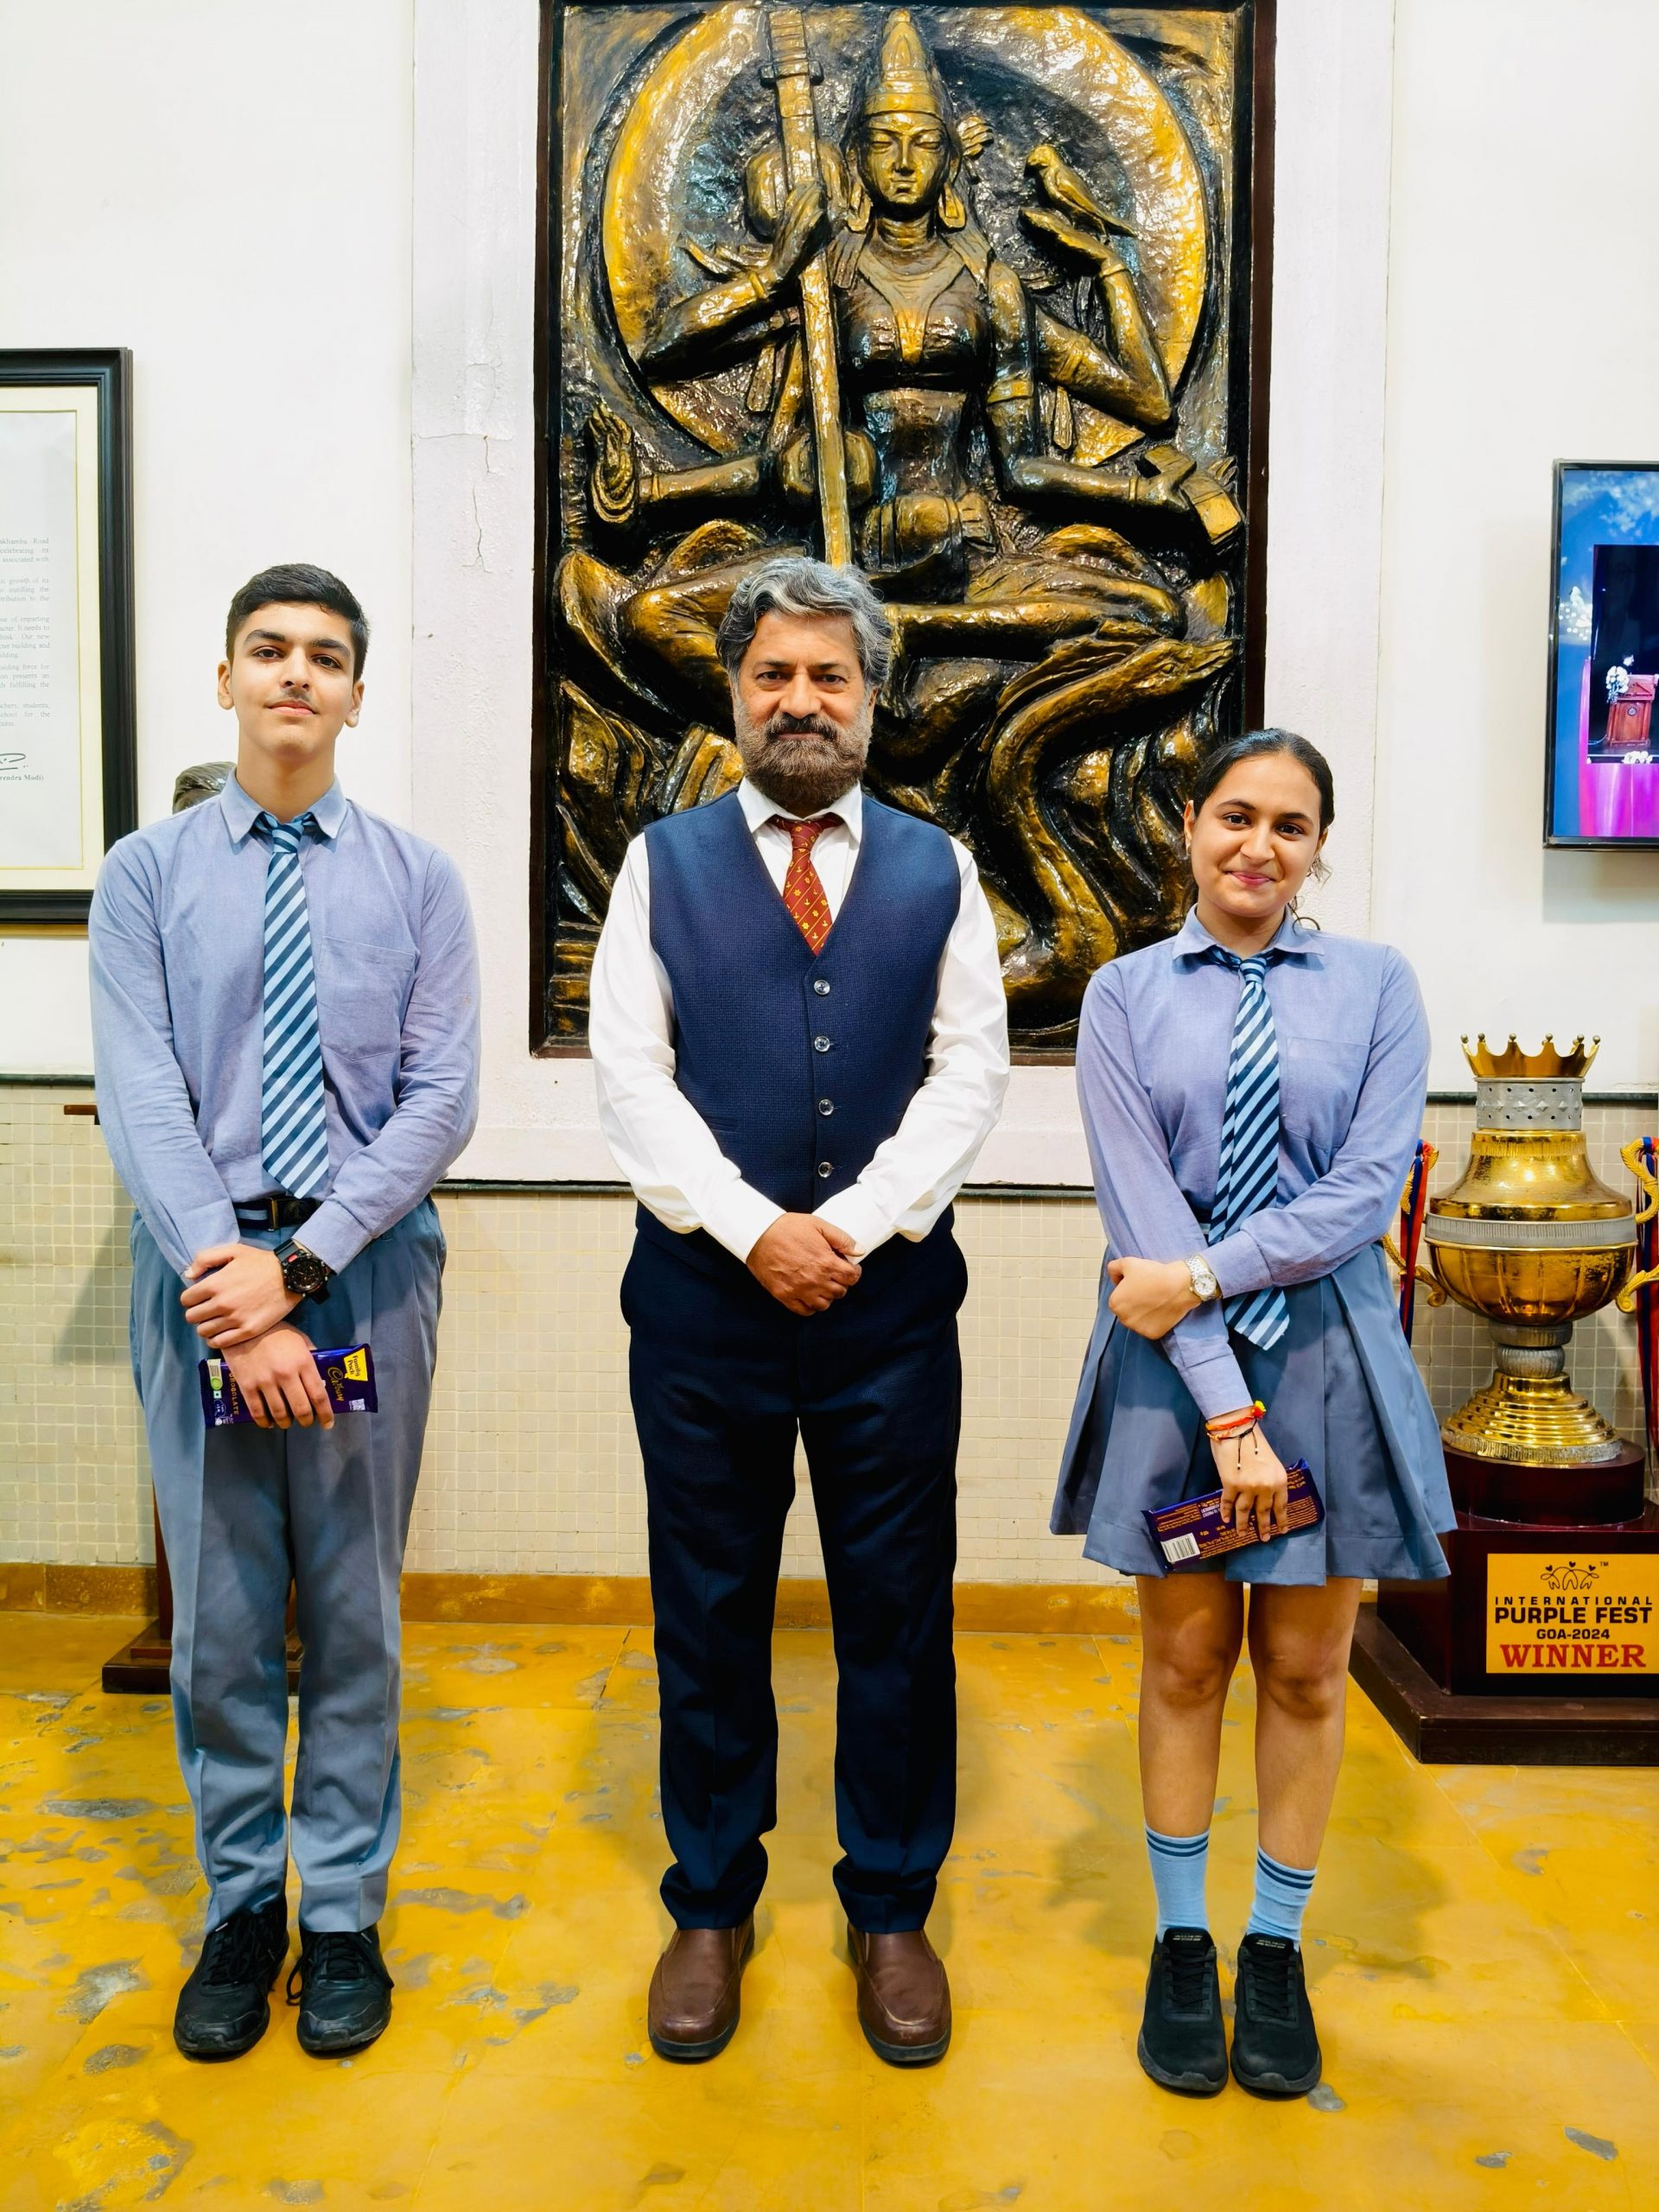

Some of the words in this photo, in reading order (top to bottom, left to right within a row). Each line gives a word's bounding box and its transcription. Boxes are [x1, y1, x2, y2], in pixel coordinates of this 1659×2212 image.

[11, 642, 36, 651] building
[353, 1354, 361, 1377] Family
[1495, 1596, 1652, 1605] INTERNATIONAL
[1495, 1607, 1586, 1624] PURPLE
[1595, 1607, 1653, 1624] FEST
[1536, 1628, 1611, 1640] GOA-2024
[1499, 1643, 1647, 1669] WINNER
